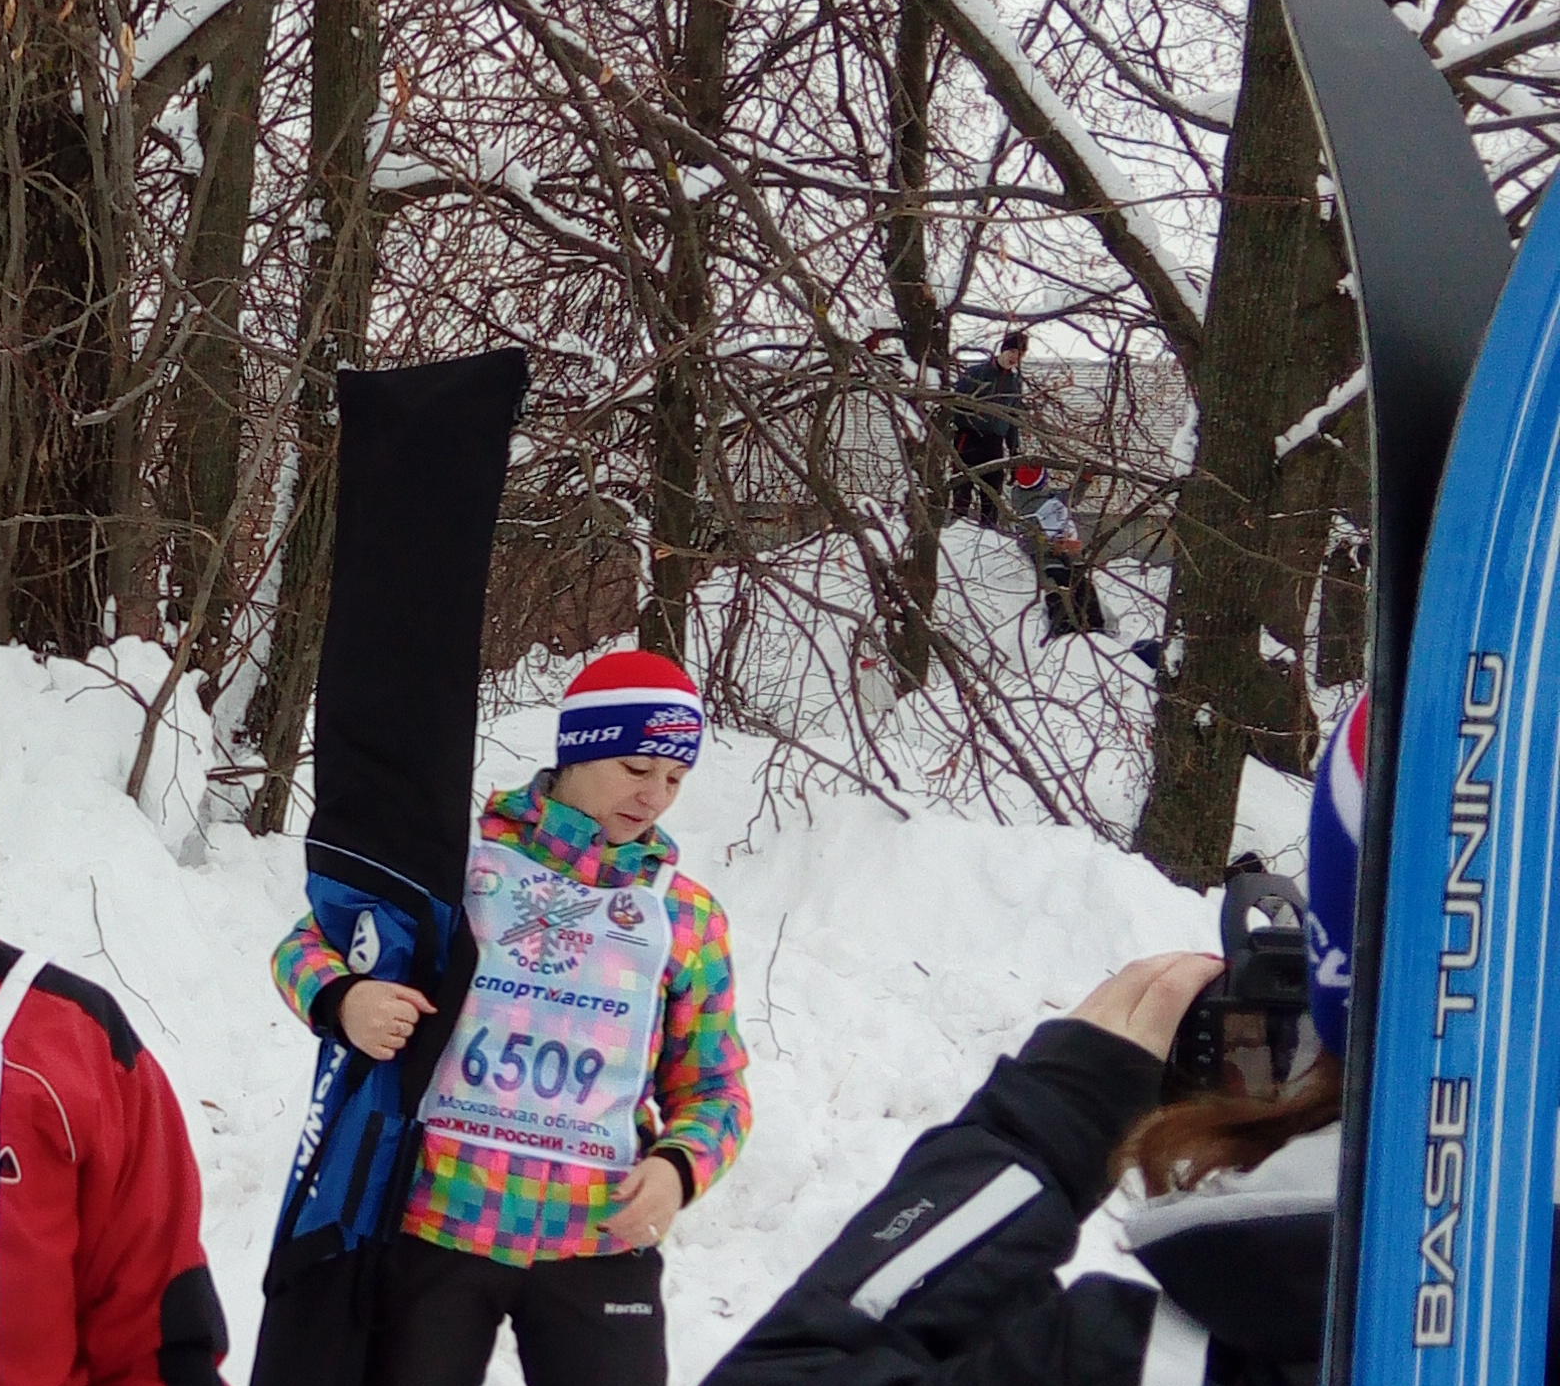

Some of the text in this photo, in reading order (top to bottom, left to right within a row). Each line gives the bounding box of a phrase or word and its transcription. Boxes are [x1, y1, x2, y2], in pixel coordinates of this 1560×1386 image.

[520, 872, 591, 897] ЛЫЖНЯ
[558, 928, 594, 945] 2018
[509, 949, 579, 975] РОССИИ
[1414, 651, 1506, 1348] BASE TUNING
[461, 1026, 605, 1105] 6509
[439, 1094, 611, 1137] Московская область
[494, 1127, 564, 1151] РОССИИ
[579, 1141, 616, 1161] 2018
